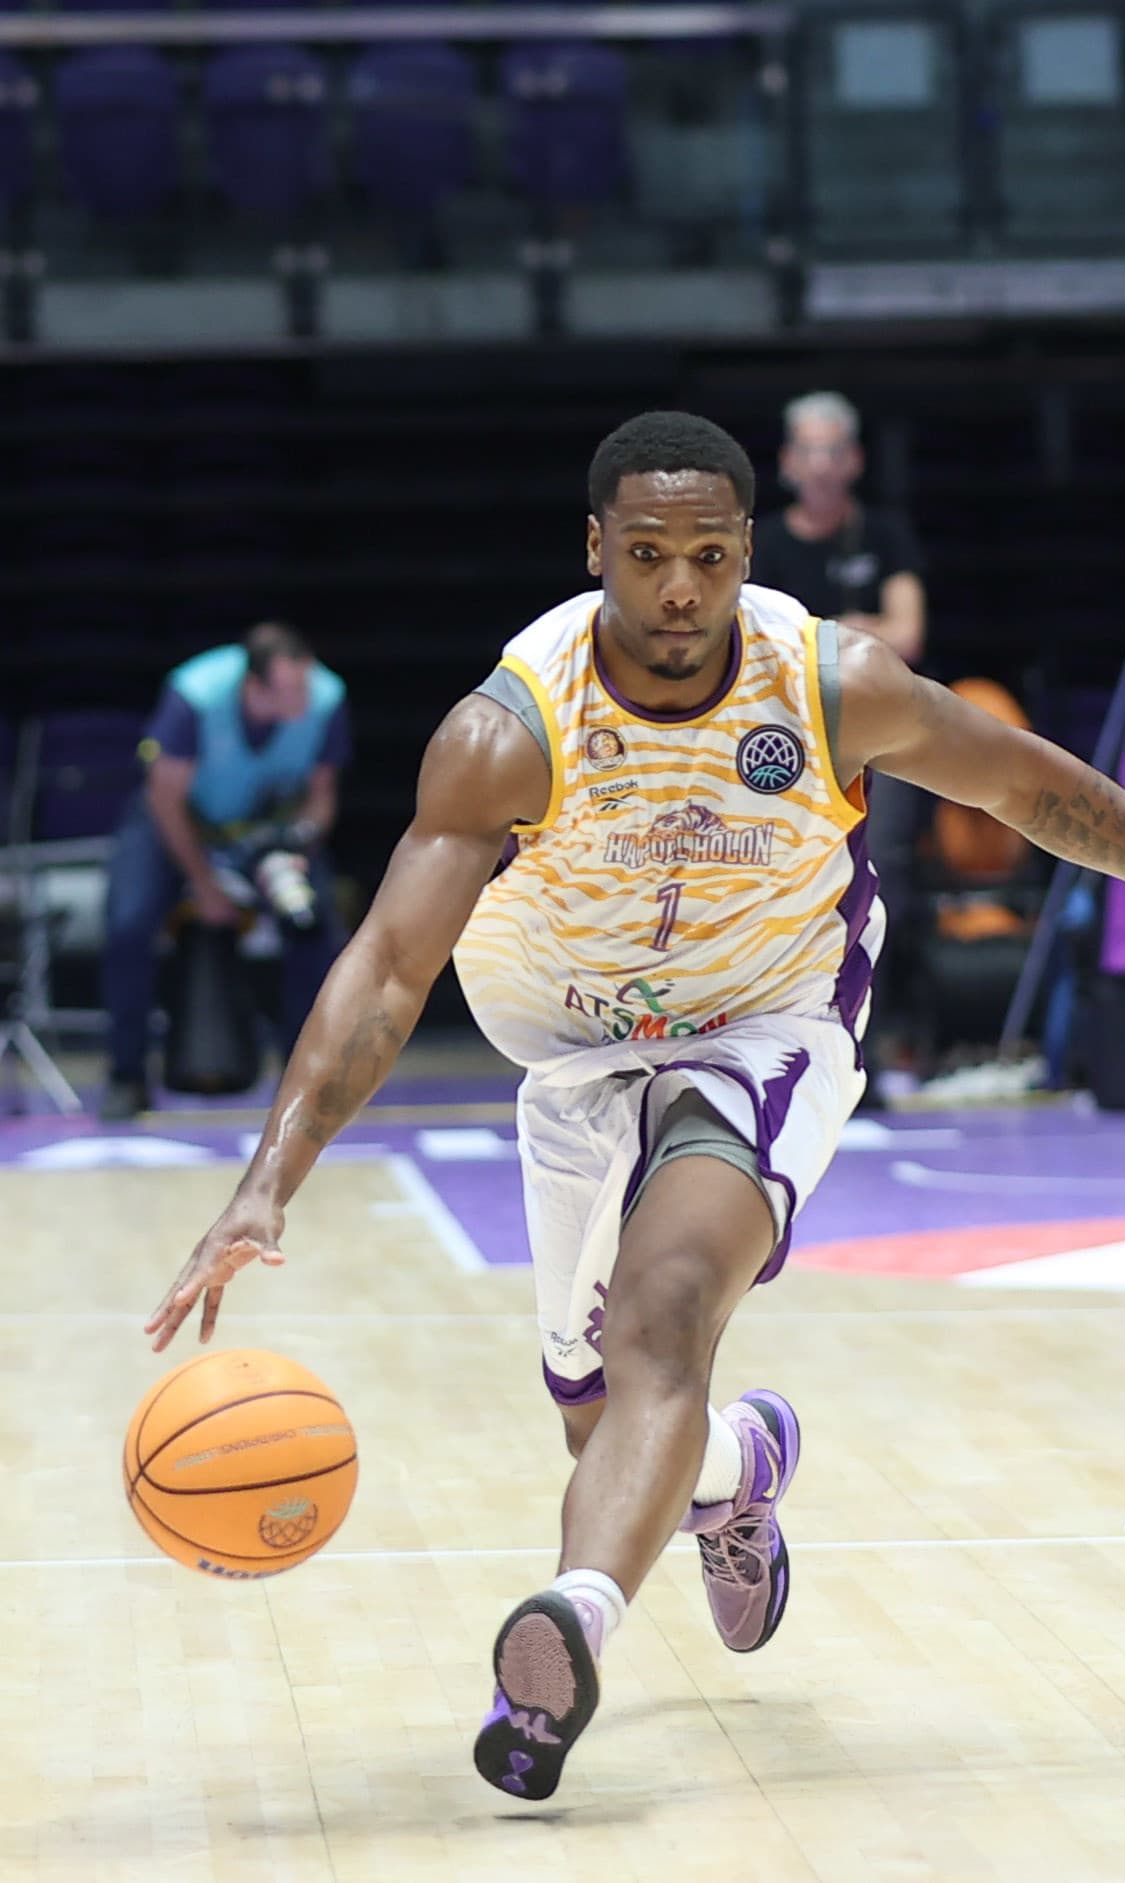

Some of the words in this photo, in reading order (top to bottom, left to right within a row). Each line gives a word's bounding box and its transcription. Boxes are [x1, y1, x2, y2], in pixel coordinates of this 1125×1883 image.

[589, 779, 639, 799] Reebok
[690, 823, 775, 865] HOLON
[649, 882, 687, 953] 1
